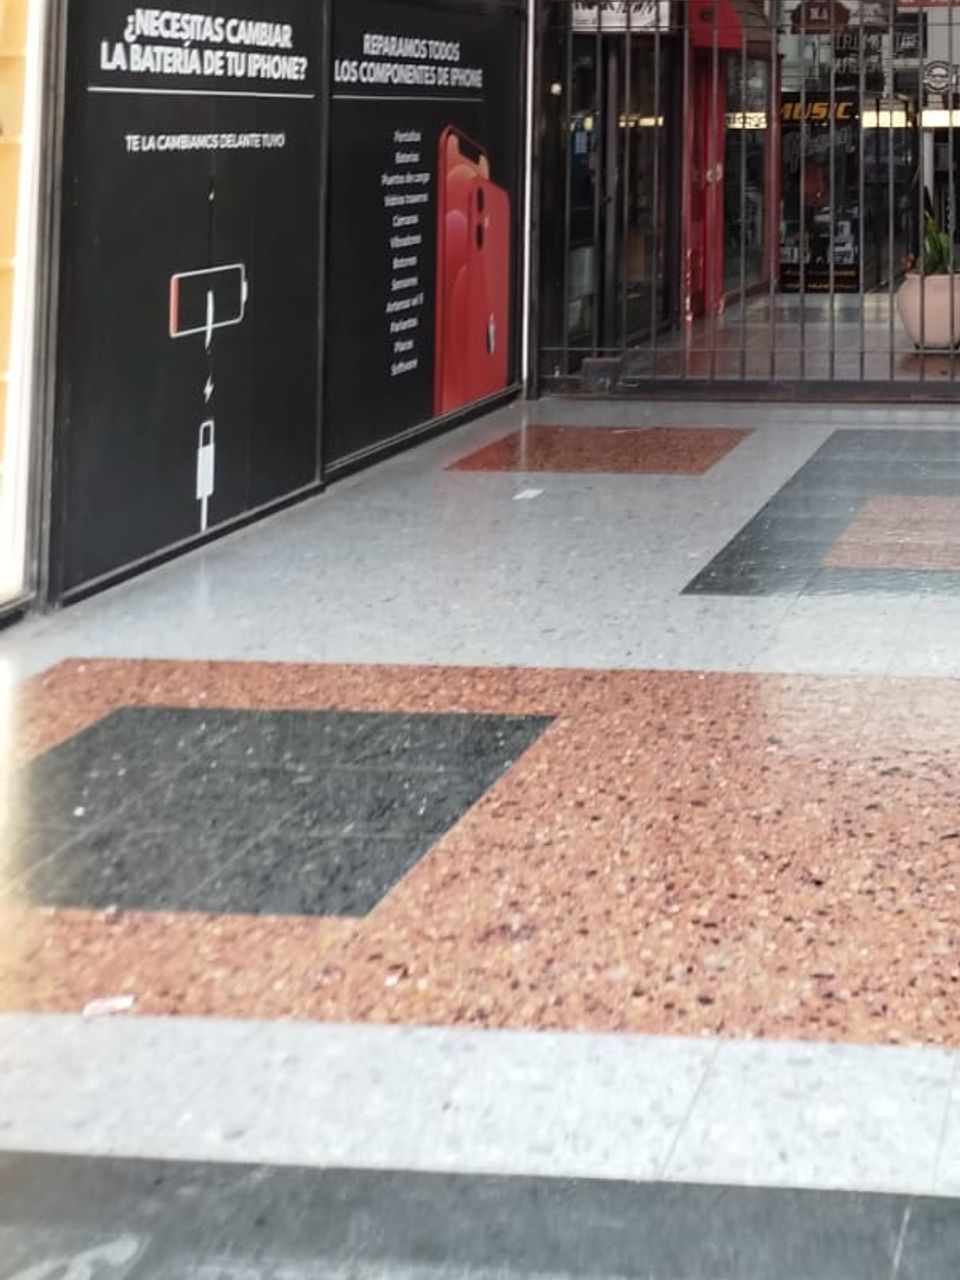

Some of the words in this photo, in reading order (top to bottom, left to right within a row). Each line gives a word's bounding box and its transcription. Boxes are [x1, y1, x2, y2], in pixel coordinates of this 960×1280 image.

[124, 8, 226, 44] ¿NECESITAS
[226, 18, 294, 50] CAMBIAR
[100, 40, 128, 72] LA
[129, 40, 202, 75] BATERÍA
[203, 50, 225, 77] DE
[226, 50, 246, 78] TU
[247, 53, 309, 82] IPHONE?
[362, 33, 428, 59] REPARAMOS
[428, 39, 461, 62] TODOS
[334, 59, 358, 83] LOS
[359, 61, 436, 85] COMPONENTES
[437, 66, 449, 87] DE
[125, 135, 141, 152] TE
[141, 135, 156, 152] LA
[156, 134, 220, 151] CAMBIAMOS
[219, 133, 262, 150] DELANTE
